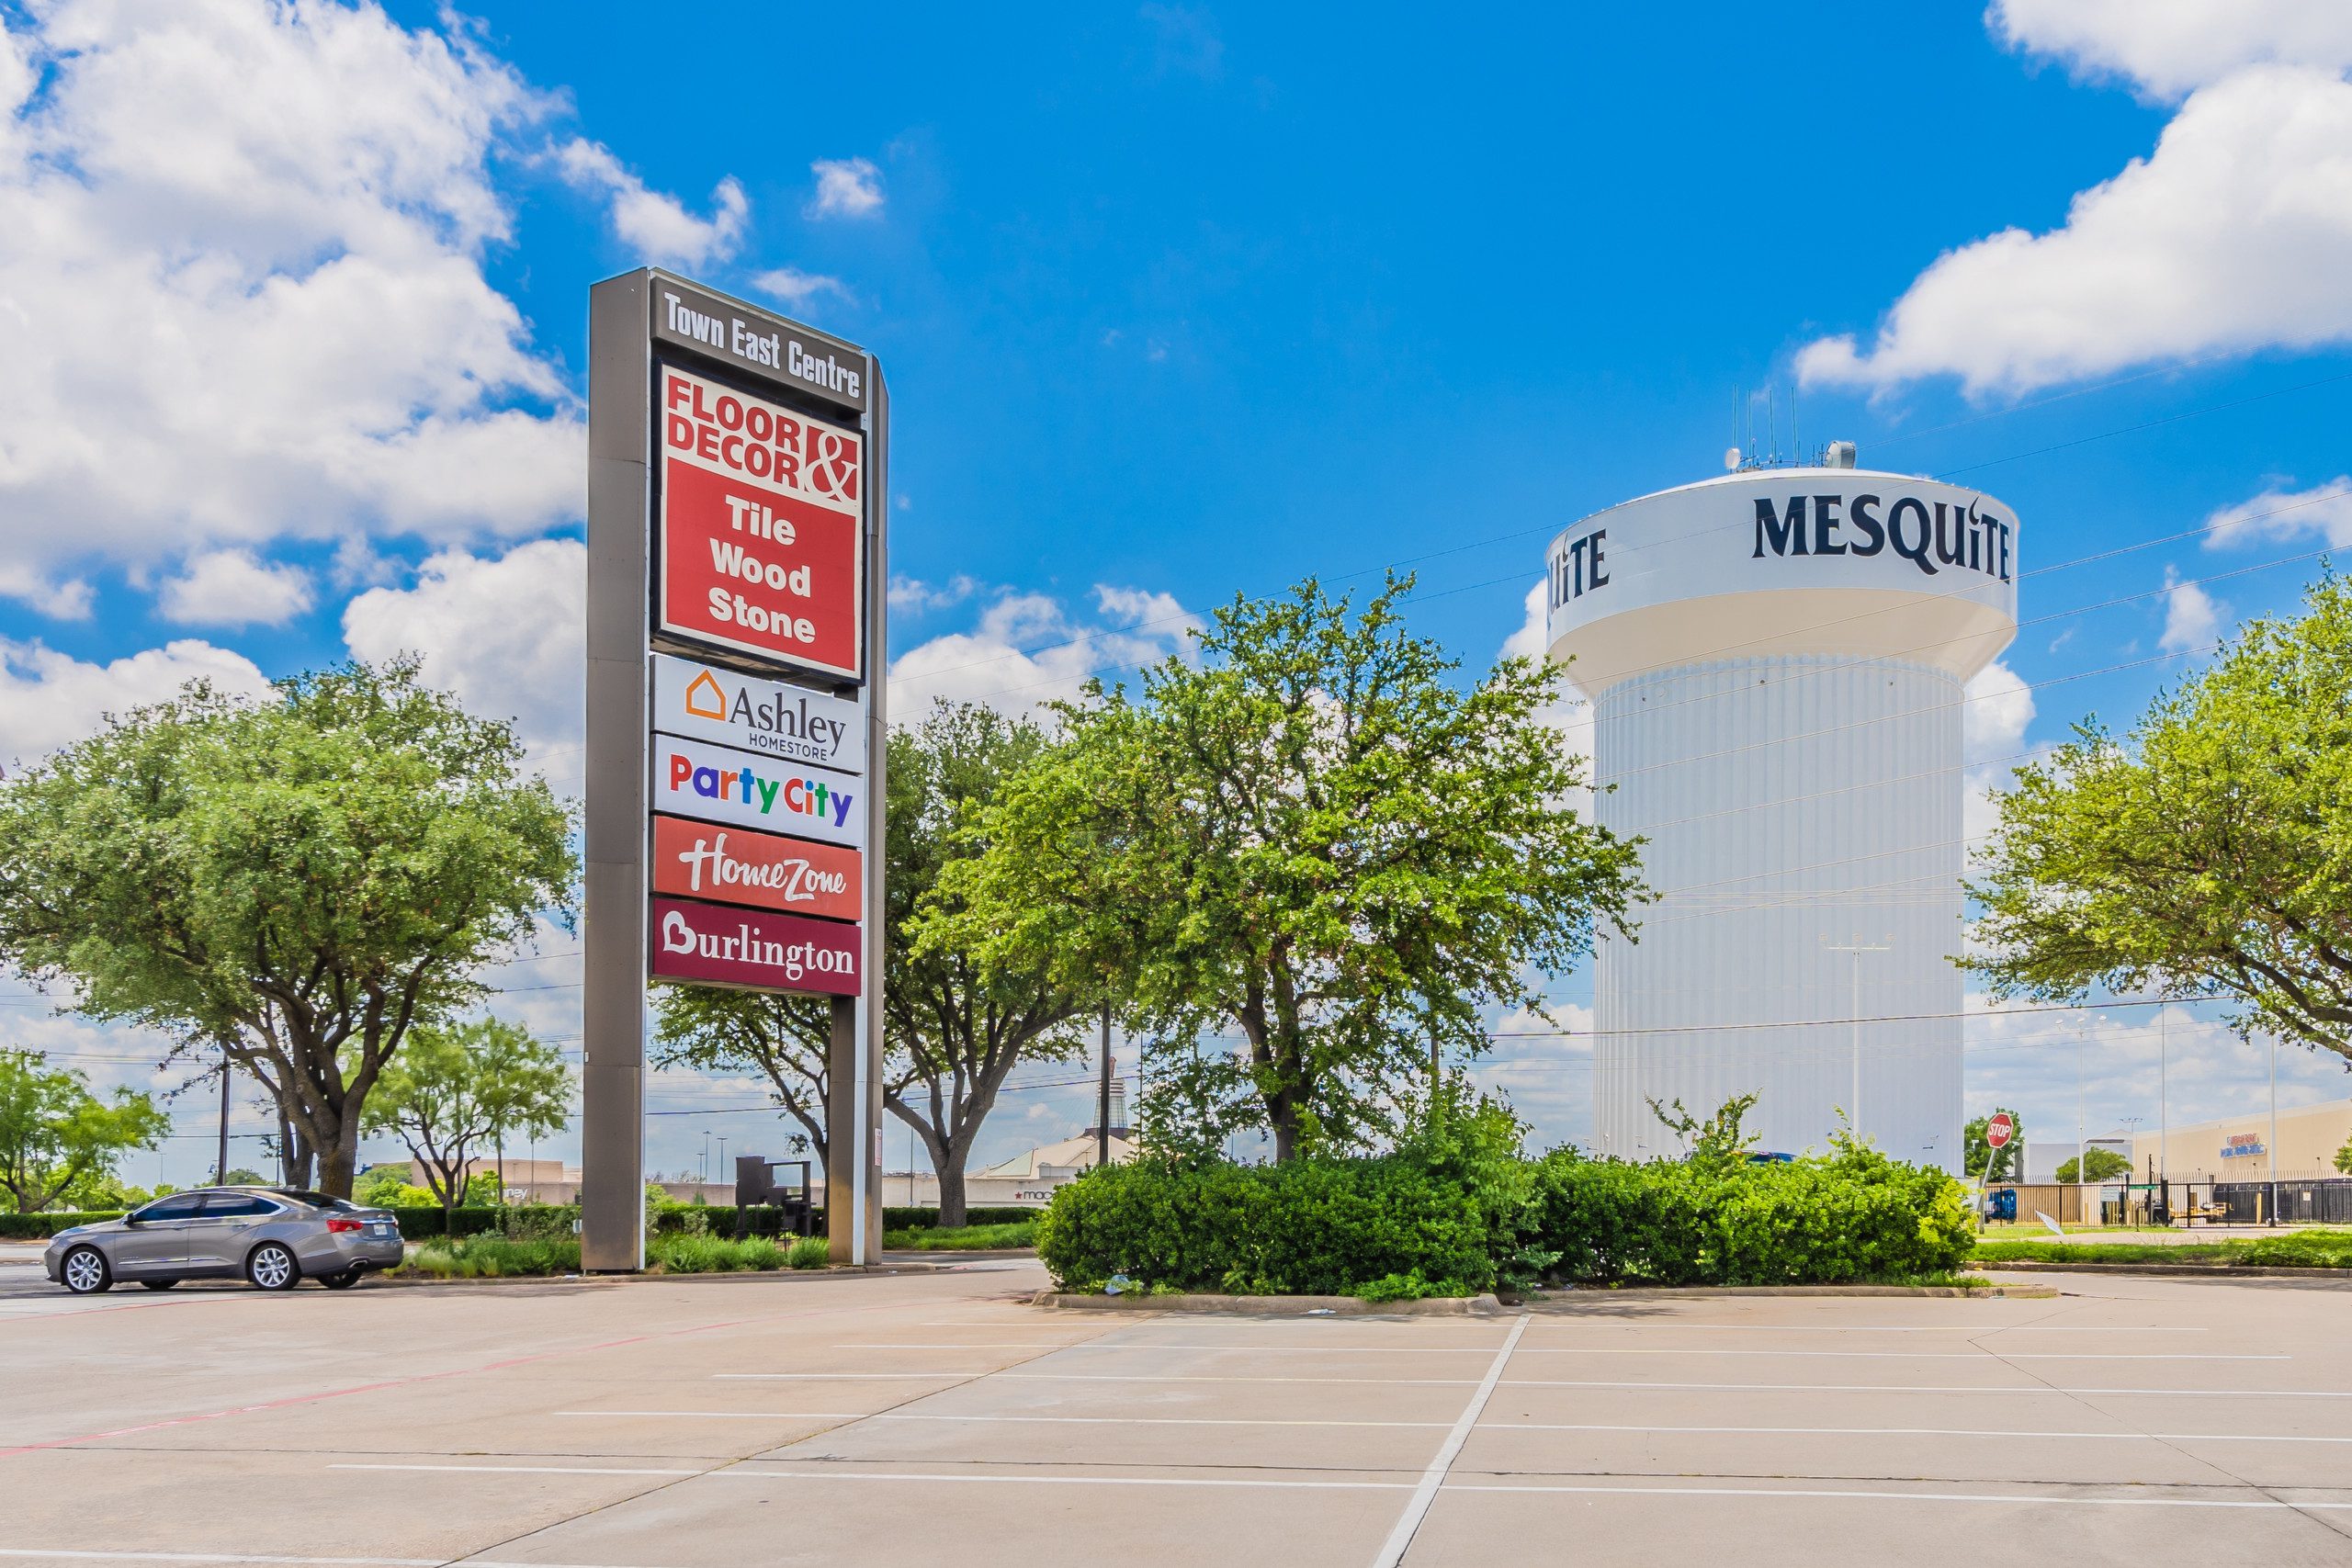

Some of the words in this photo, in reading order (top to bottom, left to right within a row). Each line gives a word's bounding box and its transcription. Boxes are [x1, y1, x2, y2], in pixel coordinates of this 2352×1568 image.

[664, 292, 724, 349] Town
[731, 318, 780, 369] East
[787, 341, 861, 399] Centre
[668, 375, 800, 454] FLOOR
[668, 412, 799, 490] DECOR
[725, 494, 797, 546] Tile
[709, 537, 811, 598] Wood
[708, 587, 816, 644] Stone
[729, 687, 846, 757] Ashley
[749, 732, 828, 761] HOMESTORE
[670, 753, 780, 815] Party
[784, 777, 854, 828] City
[662, 910, 854, 981] Burlington
[1989, 1122, 2011, 1138] STOP
[1023, 1190, 1054, 1200] mac
